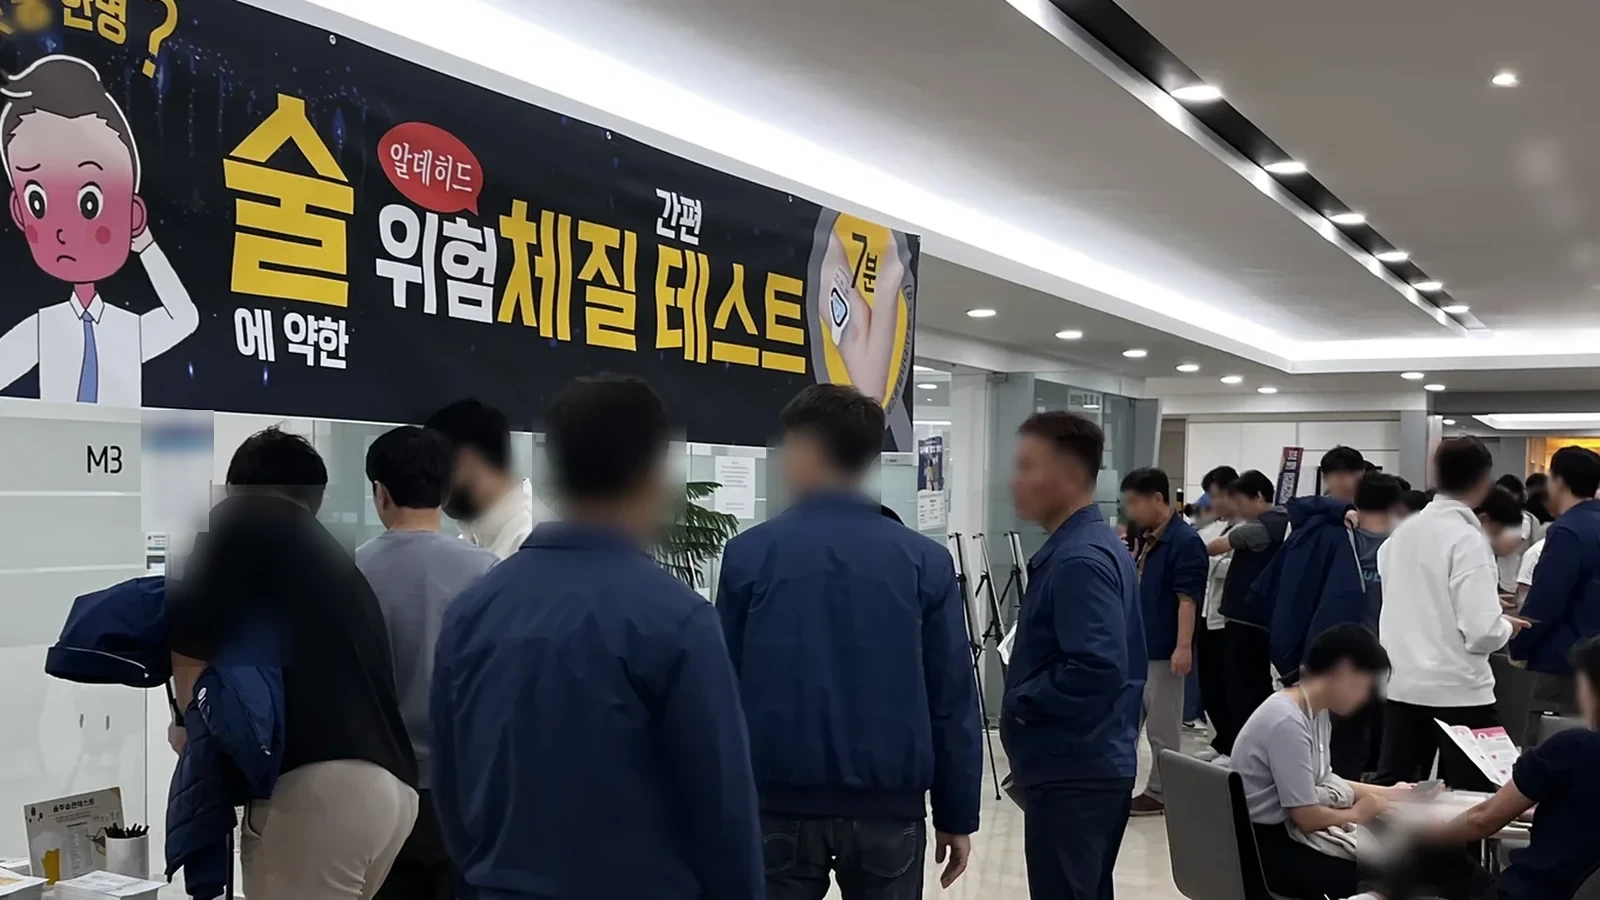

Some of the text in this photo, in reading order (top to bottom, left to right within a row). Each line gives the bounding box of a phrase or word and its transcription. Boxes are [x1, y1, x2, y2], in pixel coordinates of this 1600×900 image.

[389, 142, 473, 193] 알데히드
[223, 93, 355, 308] 술
[655, 188, 703, 246] 간편
[234, 307, 350, 370] 에 약한
[655, 245, 806, 374] 테스트
[87, 445, 122, 473] M3
